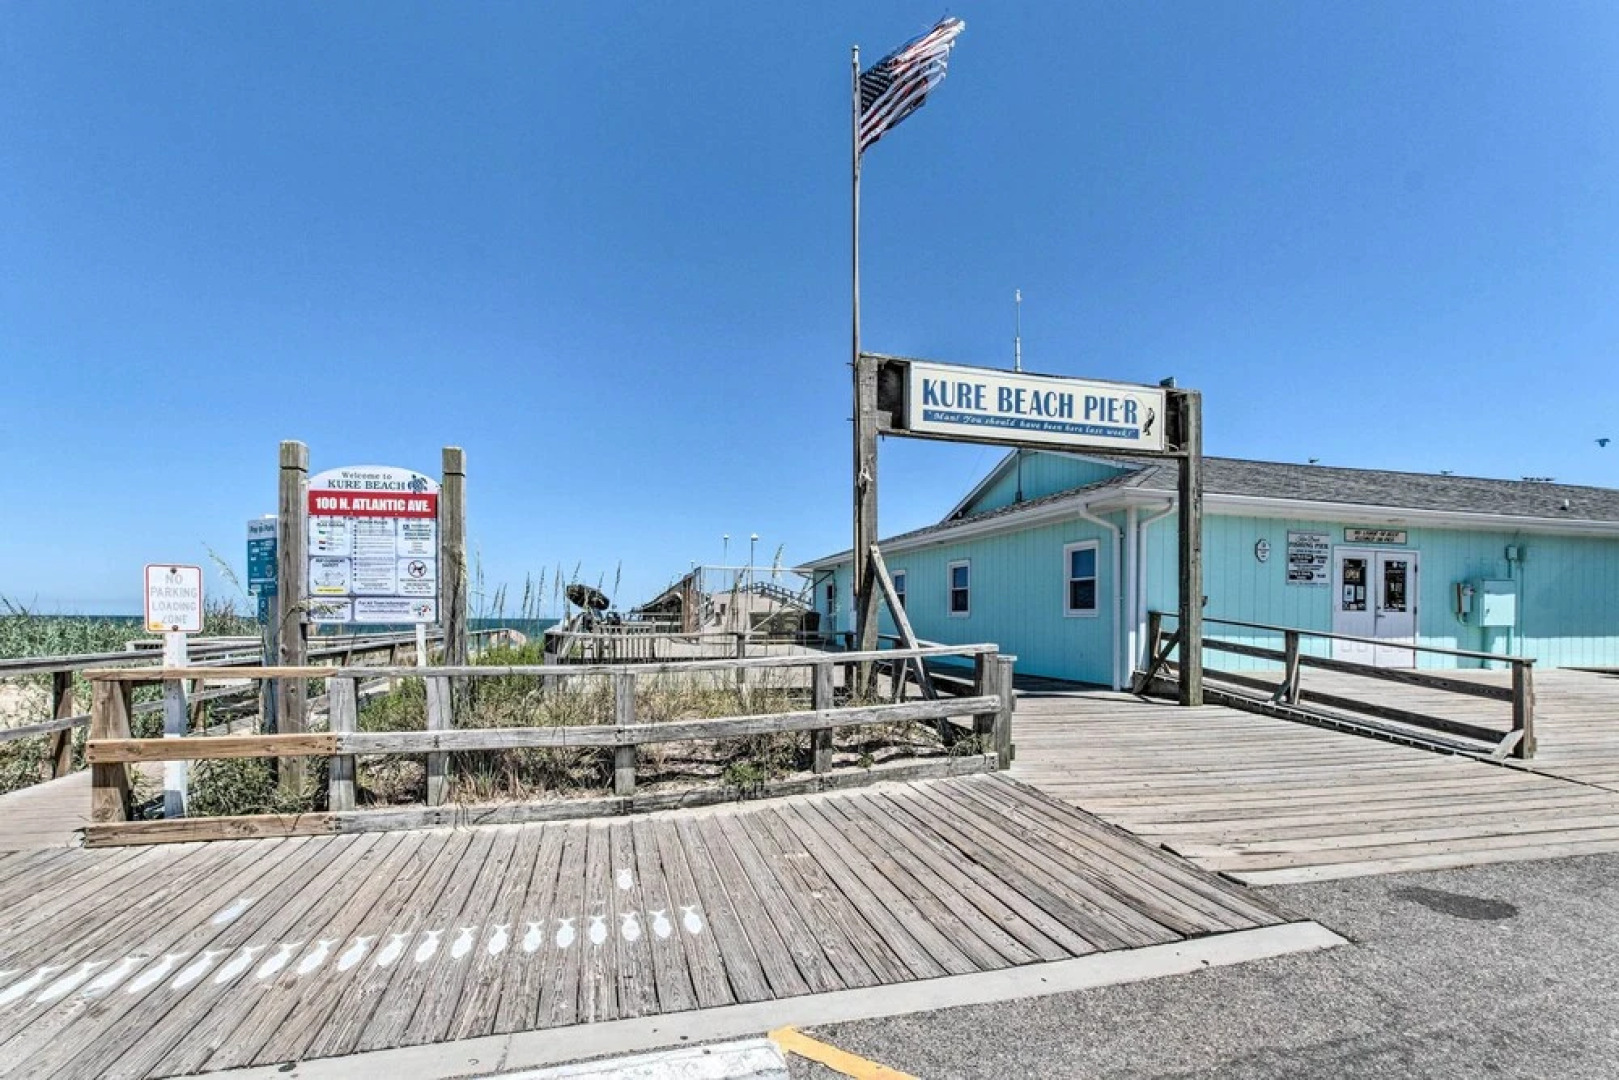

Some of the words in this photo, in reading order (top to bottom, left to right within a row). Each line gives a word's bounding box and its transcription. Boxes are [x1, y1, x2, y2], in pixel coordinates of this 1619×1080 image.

[922, 378, 987, 411] KURE
[997, 386, 1074, 419] BEACH
[1084, 394, 1138, 425] PIER
[962, 414, 982, 424] You
[985, 416, 1016, 428] should
[1019, 419, 1040, 430] have
[1043, 421, 1062, 431] been
[1064, 423, 1083, 433] here
[1085, 425, 1104, 435] last
[341, 470, 380, 480] Welcome
[383, 472, 393, 480] to
[328, 479, 362, 490] KURE
[365, 480, 405, 490] BEACH
[315, 496, 338, 510] 100
[339, 497, 351, 510] N.
[352, 498, 406, 512] ATLANTIC
[407, 499, 432, 513] AVE.
[165, 573, 184, 585] NO
[150, 586, 198, 599] PARKING
[151, 600, 197, 612] LOADING
[161, 613, 188, 625] ZONE
